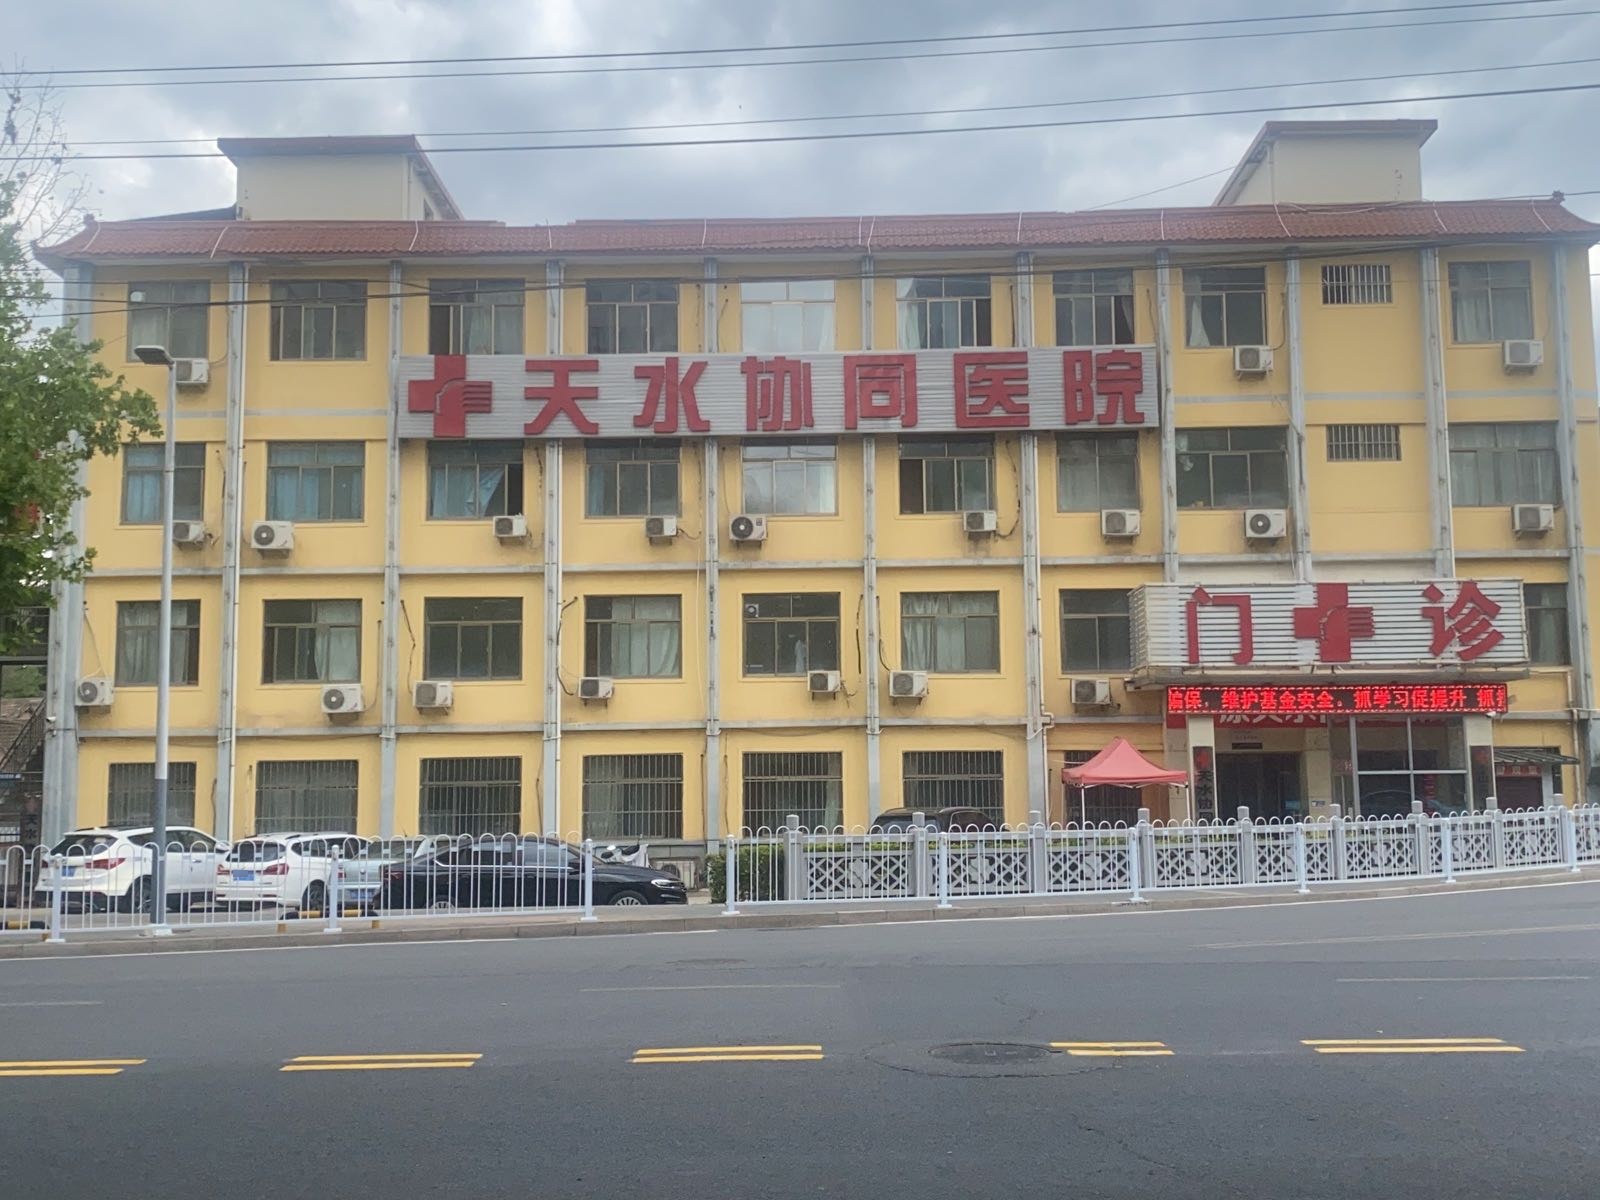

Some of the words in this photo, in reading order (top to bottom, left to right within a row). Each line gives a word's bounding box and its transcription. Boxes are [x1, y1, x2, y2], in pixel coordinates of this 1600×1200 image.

[524, 350, 1145, 435] 天水协同医院
[1185, 580, 1505, 664] 门诊
